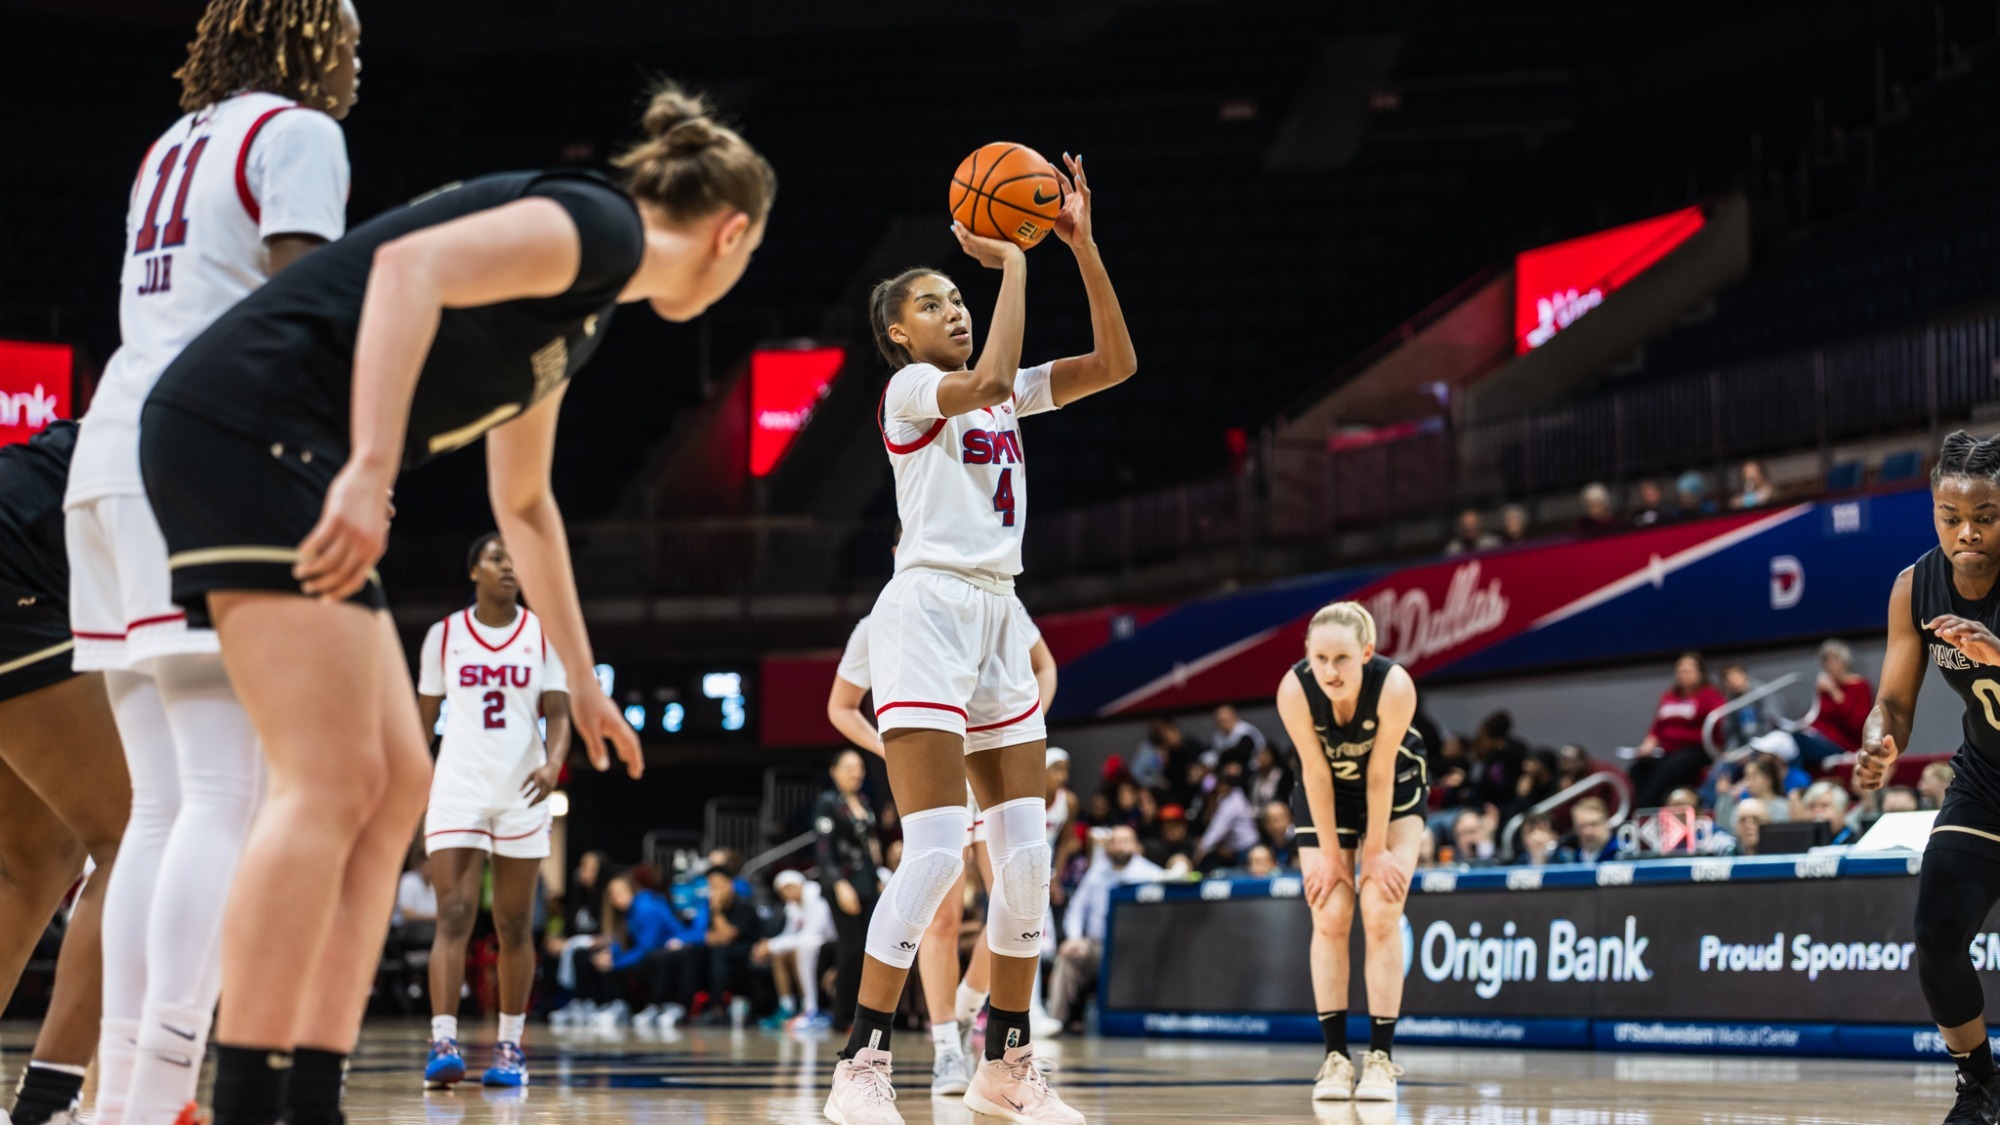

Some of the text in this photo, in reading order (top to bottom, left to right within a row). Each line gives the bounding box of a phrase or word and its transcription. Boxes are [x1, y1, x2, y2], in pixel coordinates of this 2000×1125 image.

[134, 135, 212, 256] 11
[992, 467, 1016, 528] 4
[459, 664, 532, 688] SMU
[482, 691, 507, 730] 2
[1331, 761, 1361, 780] 2
[1420, 915, 1650, 999] Origin Bank
[1699, 932, 1917, 982] Proud Sponsor
